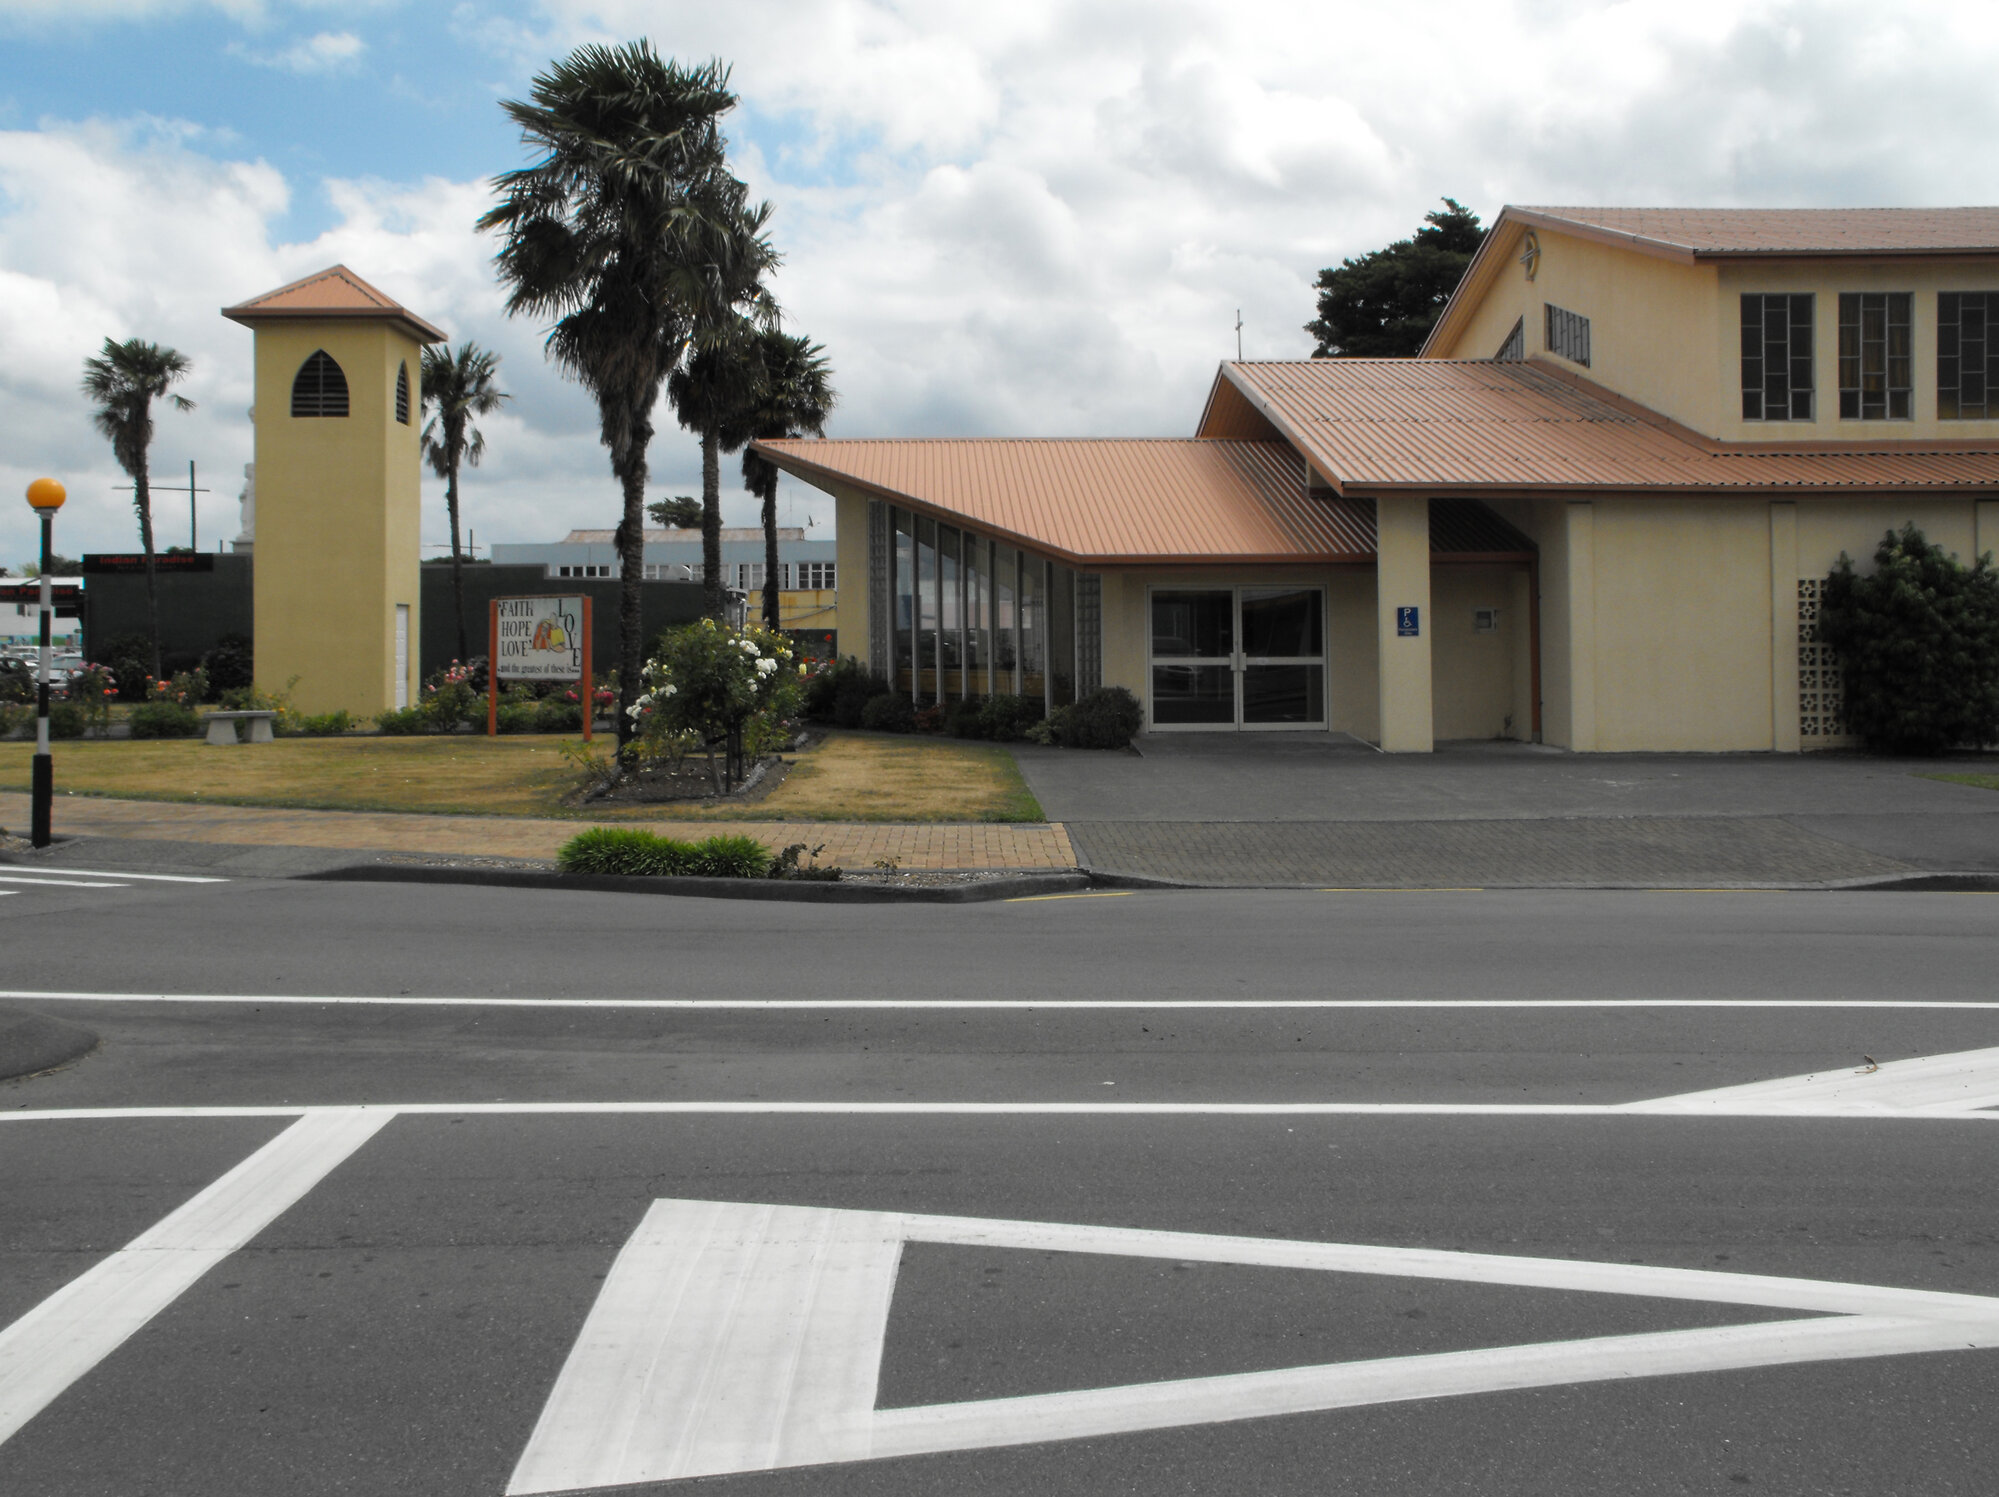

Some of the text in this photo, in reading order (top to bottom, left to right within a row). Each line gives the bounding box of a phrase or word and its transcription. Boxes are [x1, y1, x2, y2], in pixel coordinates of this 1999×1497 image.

[142, 555, 195, 564] Pradise
[1404, 608, 1411, 617] P
[502, 620, 532, 637] HOPE
[558, 599, 581, 667] LOVE
[512, 663, 520, 673] the
[521, 664, 542, 674] greatest
[544, 663, 550, 673] of
[551, 663, 565, 673] these
